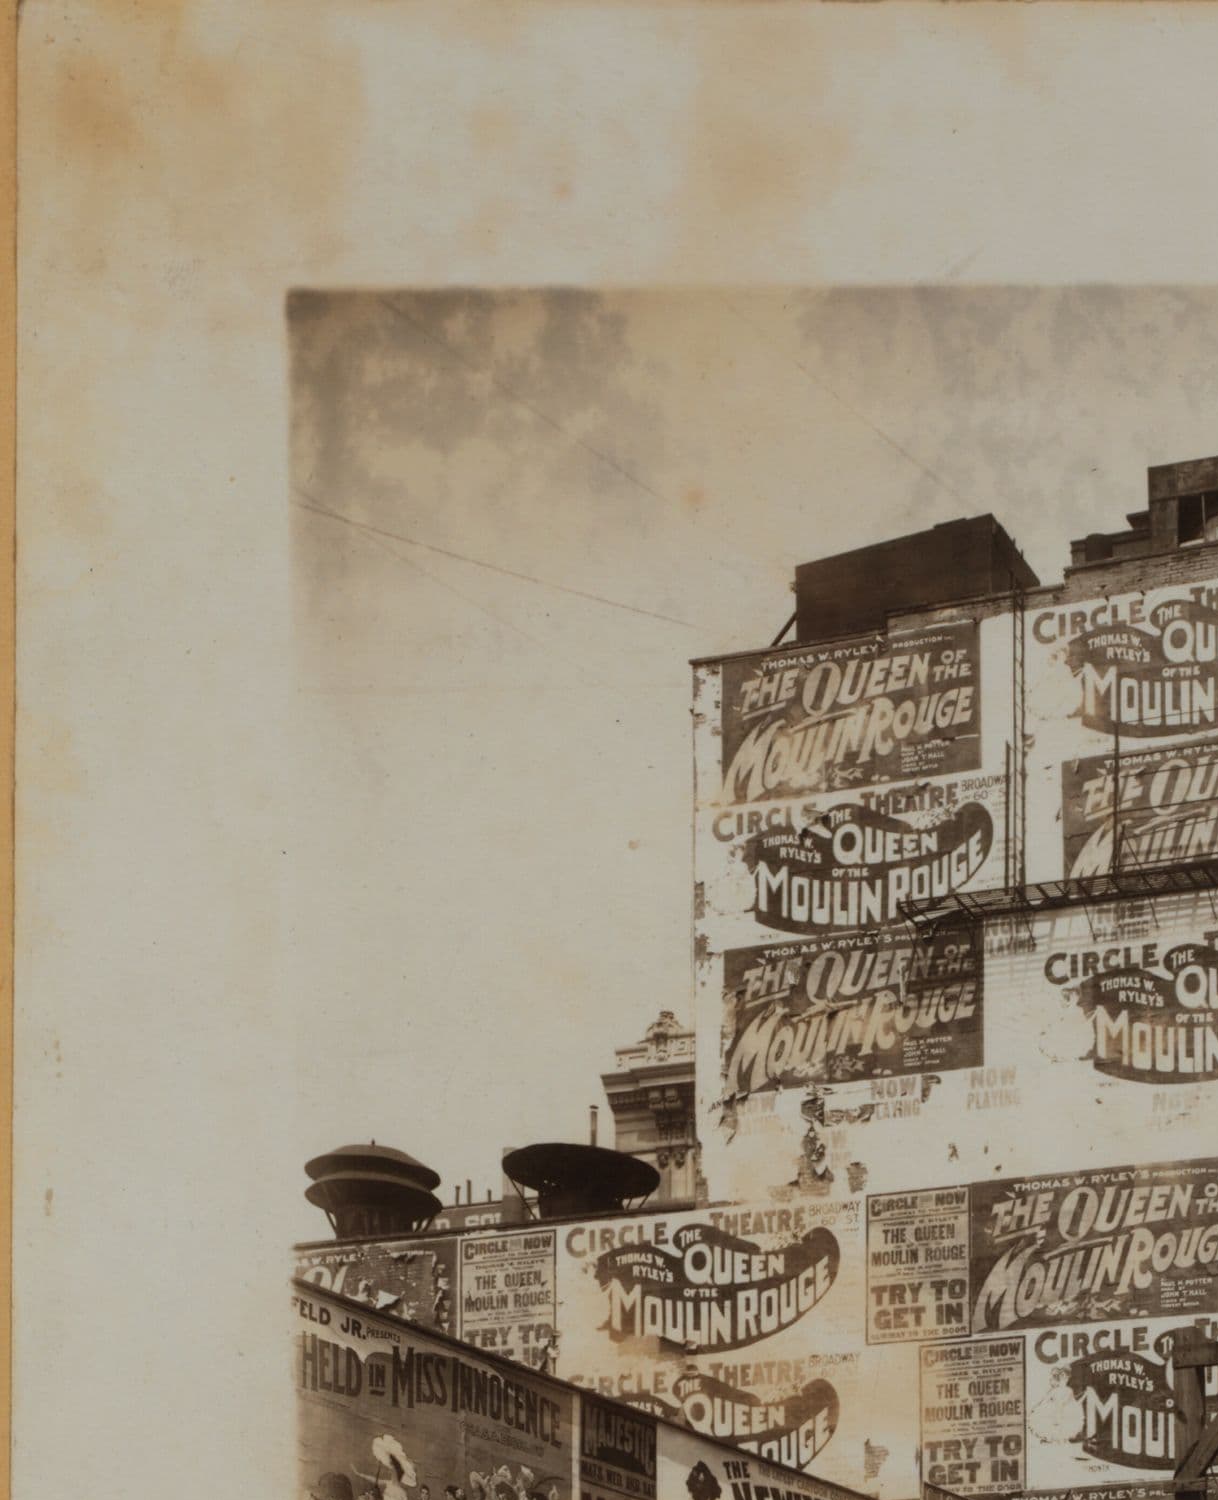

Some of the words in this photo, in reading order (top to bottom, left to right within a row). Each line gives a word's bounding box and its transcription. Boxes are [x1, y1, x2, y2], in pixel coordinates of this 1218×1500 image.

[1032, 601, 1147, 644] CIRCLE
[1157, 604, 1182, 624] THE
[736, 667, 799, 716] THE
[802, 651, 932, 716] QUEEN
[941, 650, 967, 664] OF
[1083, 663, 1216, 726] MOULIN
[858, 687, 975, 765] ROUGE
[829, 809, 852, 827] THE
[832, 823, 938, 864] QUEEN
[757, 860, 883, 926] MOULIN
[888, 829, 983, 921] ROUGE
[1044, 943, 1159, 984] CIRCLE
[1170, 949, 1195, 966] THE
[935, 1191, 967, 1206] NOW
[1013, 1178, 1070, 1192] THOMAS
[991, 1192, 1054, 1237] THE
[1057, 1183, 1194, 1243] QUEEN
[566, 1222, 669, 1257] CIRCLE
[709, 1207, 805, 1236] THEATRE
[809, 1201, 861, 1217] BROADWAY
[679, 1227, 702, 1245] THE
[882, 1227, 907, 1244] THE
[914, 1223, 955, 1241] QUEEN
[615, 1253, 652, 1266] THOMAS
[683, 1242, 785, 1285] QUEEN
[871, 1250, 919, 1268] MOULIN
[925, 1245, 966, 1262] ROUGE
[632, 1266, 674, 1282] RYLEY'S
[973, 1234, 1126, 1332] MOULIN
[611, 1279, 733, 1346] MOULIN
[737, 1255, 830, 1340] ROUGE
[870, 1283, 923, 1307] TRY
[930, 1279, 967, 1300] TO
[294, 1298, 331, 1325] ELD
[341, 1317, 367, 1340] JR.
[367, 1326, 400, 1342] PRESENTS
[874, 1307, 926, 1330] GET
[936, 1303, 964, 1325] IN
[989, 1342, 1021, 1356] NOW
[1034, 1327, 1149, 1365] CIRCLE
[1090, 1360, 1132, 1373] THOMAS
[302, 1331, 362, 1397] HELD
[369, 1362, 385, 1395] IN
[392, 1344, 448, 1409] MISS
[451, 1356, 562, 1449] INNOCENCE
[679, 1378, 702, 1397] THE
[936, 1383, 960, 1399] THE
[968, 1379, 1010, 1396] QUEEN
[1108, 1373, 1154, 1392] RYLEY'S
[683, 1393, 785, 1437] QUEEN
[979, 1399, 1021, 1417] ROUGE
[583, 1404, 655, 1477] MAJESTIC
[924, 1439, 978, 1462] TRY
[984, 1434, 1023, 1457] TO
[723, 1461, 750, 1479] THE
[928, 1462, 981, 1485] GET
[991, 1459, 1019, 1482] IN
[1089, 1488, 1147, 1500] RYLEY'S
